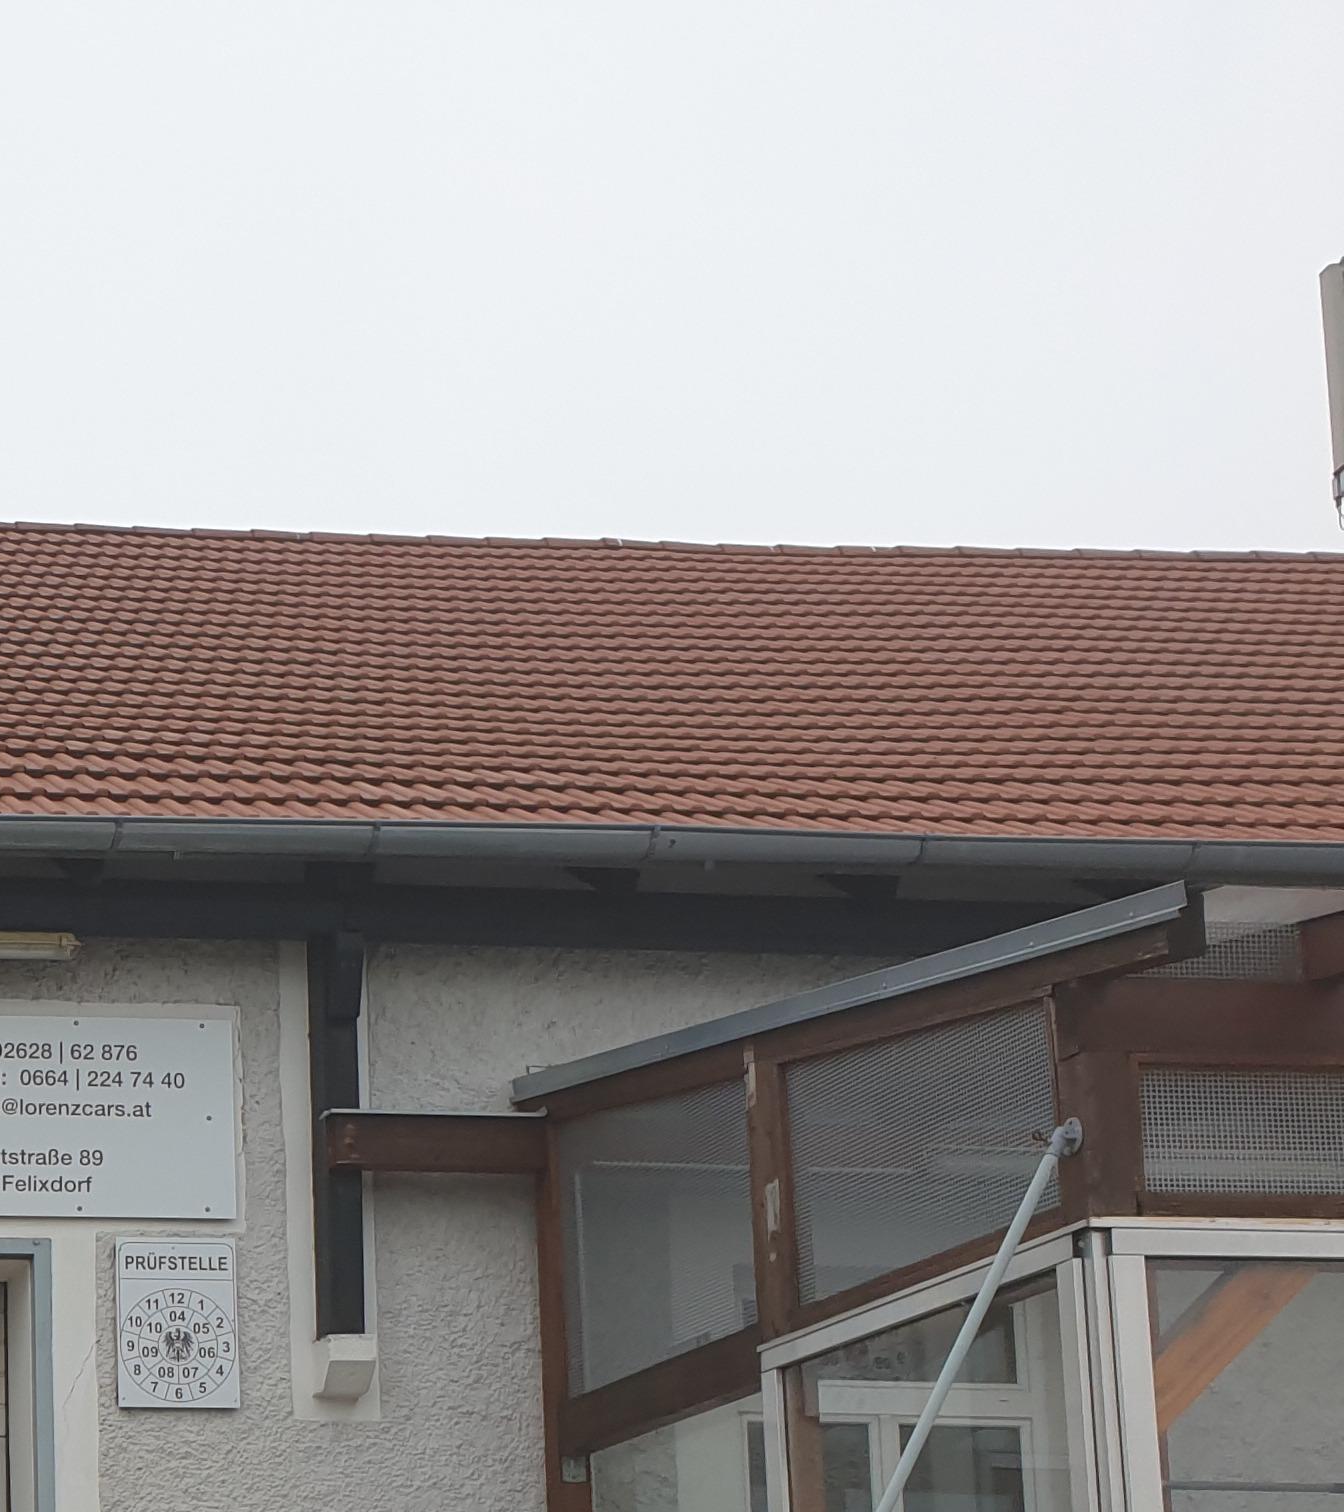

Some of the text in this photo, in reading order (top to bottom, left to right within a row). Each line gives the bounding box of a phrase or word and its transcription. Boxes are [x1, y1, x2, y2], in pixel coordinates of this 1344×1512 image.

[69, 1043, 95, 1061] 62
[100, 1044, 138, 1062] 876
[19, 1069, 69, 1087] 0664
[86, 1070, 123, 1088] 224
[130, 1071, 154, 1089] 74
[160, 1072, 185, 1089] 40
[79, 1149, 104, 1167] 89
[1, 1174, 93, 1193] Felixdorf
[124, 1252, 229, 1271] PRÜFSTELLE
[145, 1298, 160, 1311] 11
[169, 1292, 185, 1305] 12
[127, 1316, 142, 1328] 10
[169, 1310, 186, 1323] 04
[215, 1316, 224, 1329] 2
[147, 1322, 162, 1334] 10
[193, 1323, 210, 1335] 05
[126, 1340, 135, 1352] 9
[141, 1346, 158, 1358] 09
[198, 1346, 216, 1358] 06
[222, 1341, 231, 1353] 3
[133, 1364, 142, 1376] 8
[157, 1366, 174, 1379] 08
[182, 1366, 199, 1379] 07
[215, 1364, 224, 1377] 4
[150, 1381, 159, 1393] 7
[174, 1387, 183, 1400] 6
[198, 1382, 207, 1394] 5
